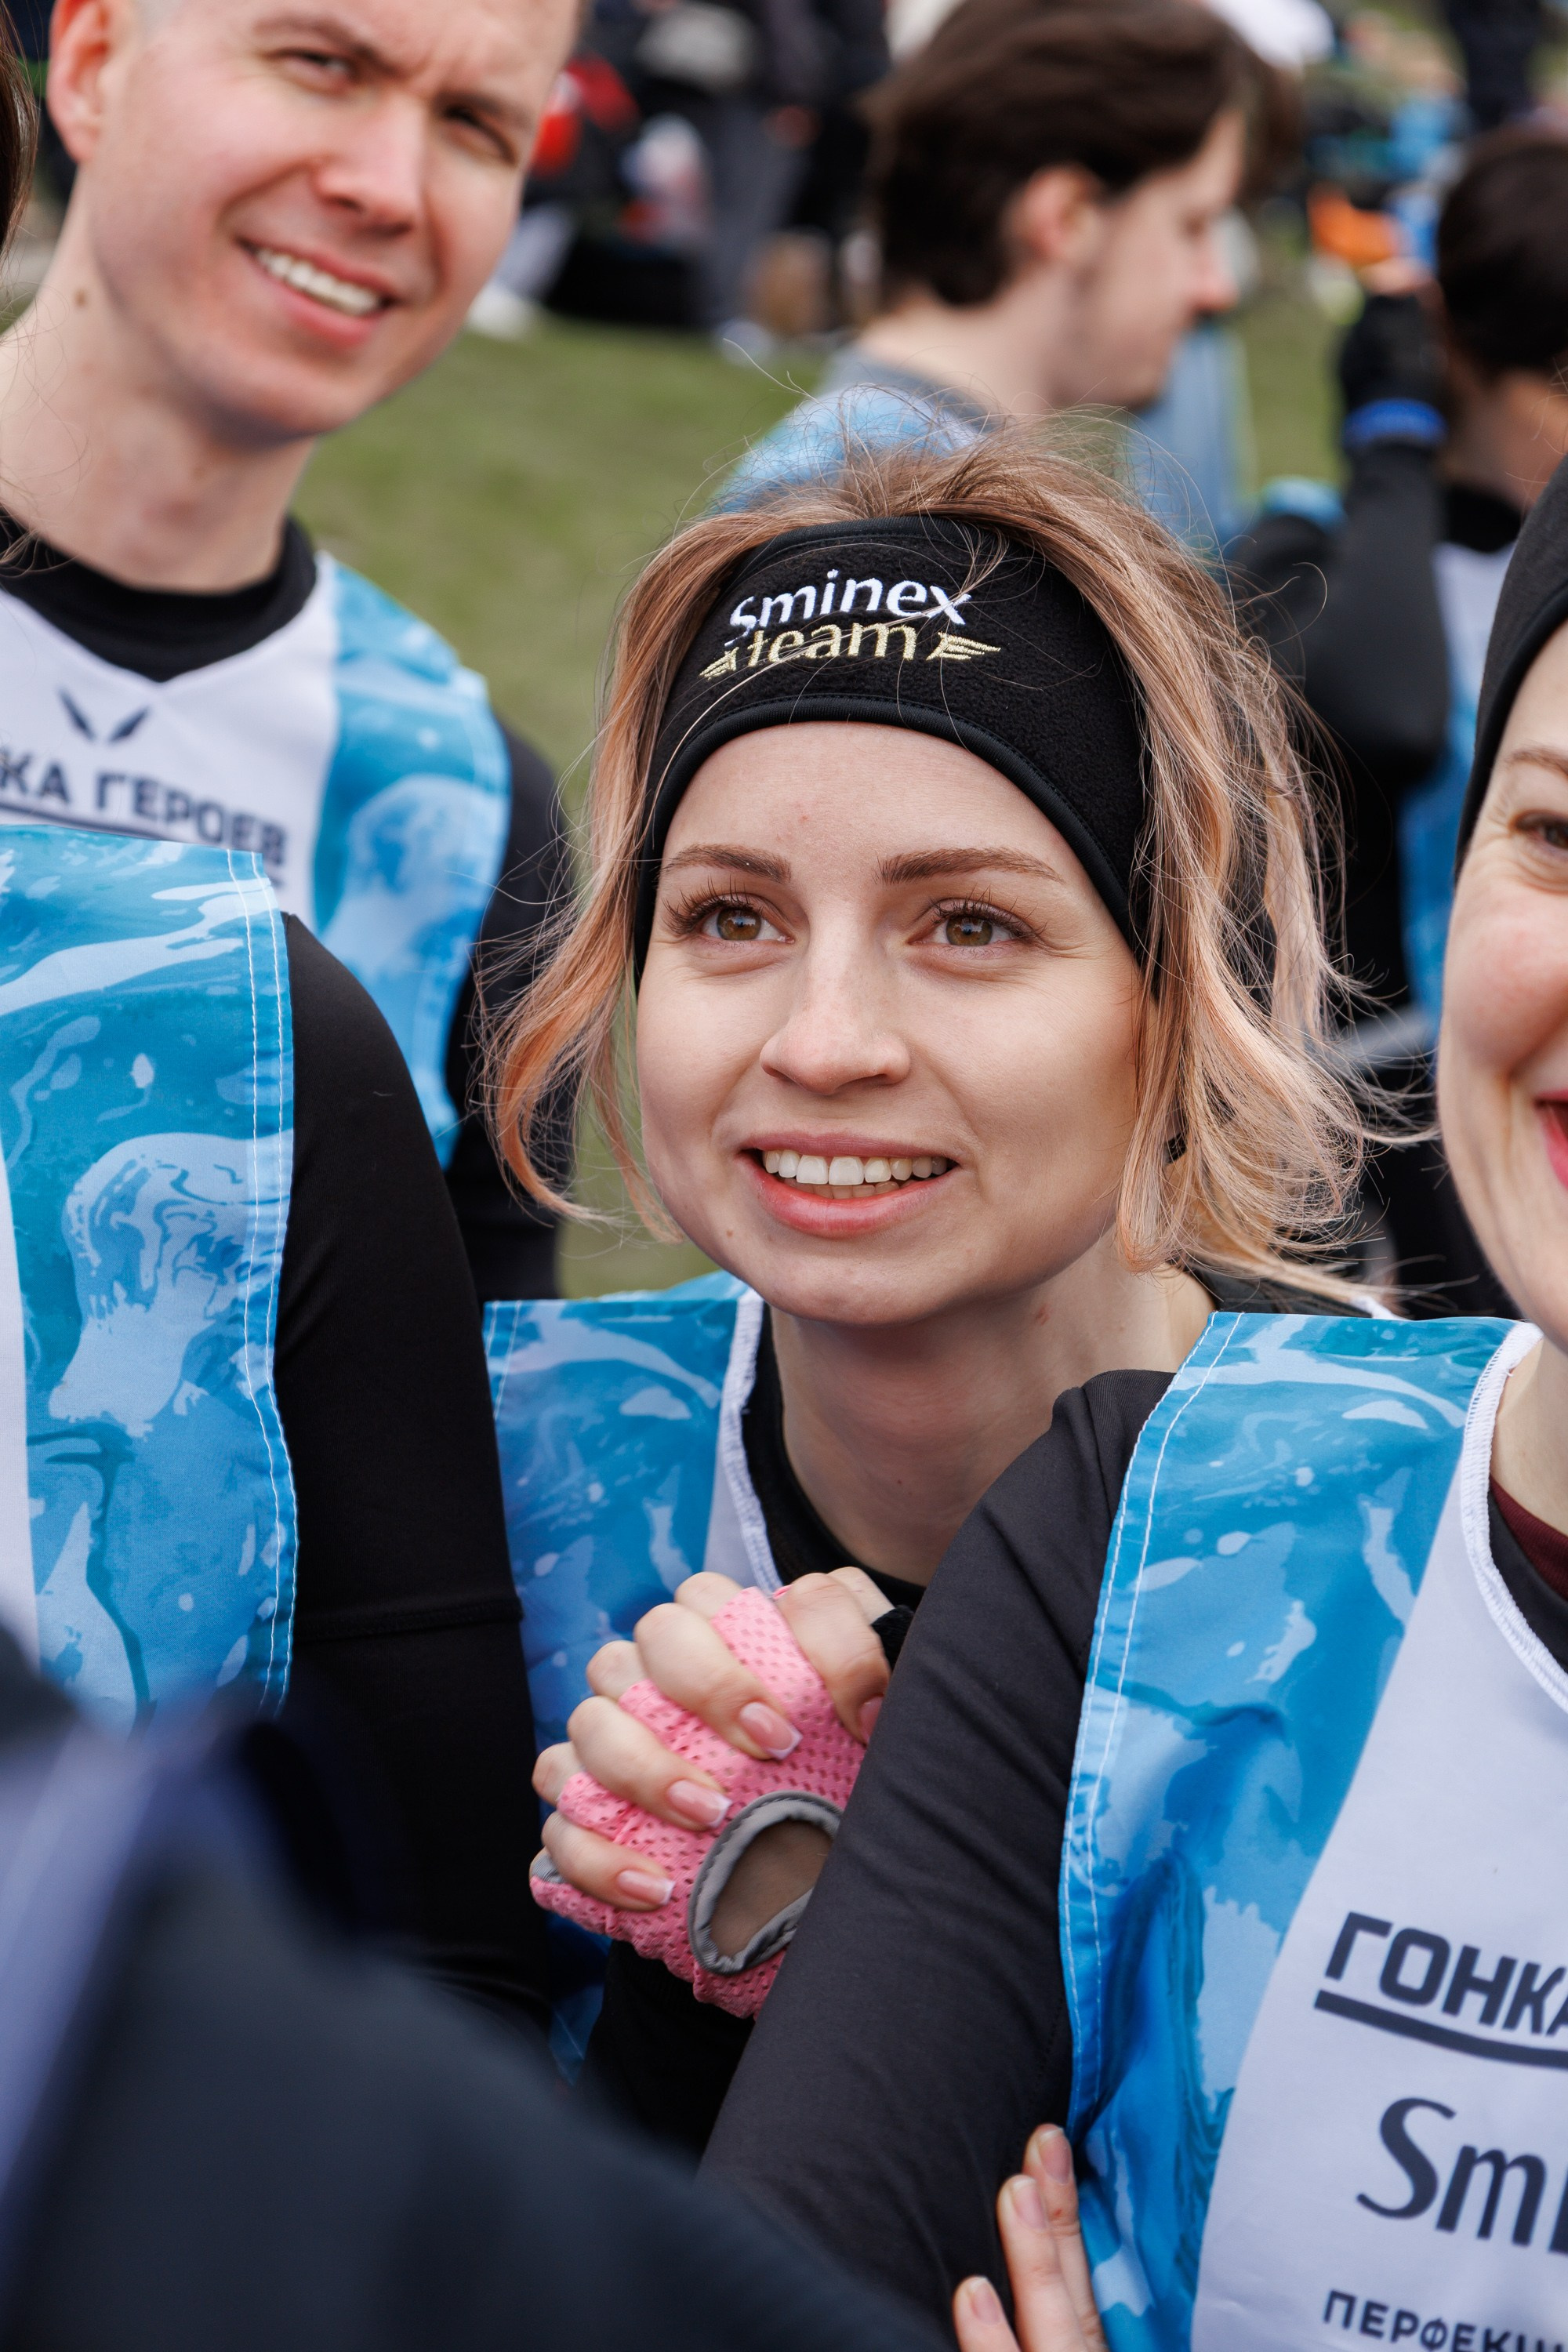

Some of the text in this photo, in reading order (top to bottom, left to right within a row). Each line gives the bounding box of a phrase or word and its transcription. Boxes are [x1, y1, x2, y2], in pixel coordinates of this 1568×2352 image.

[724, 568, 971, 647] Sminex
[747, 622, 917, 669] team
[96, 770, 288, 866] ГЕРОЕВ
[1323, 2289, 1565, 2352] ПЕРФЕК
